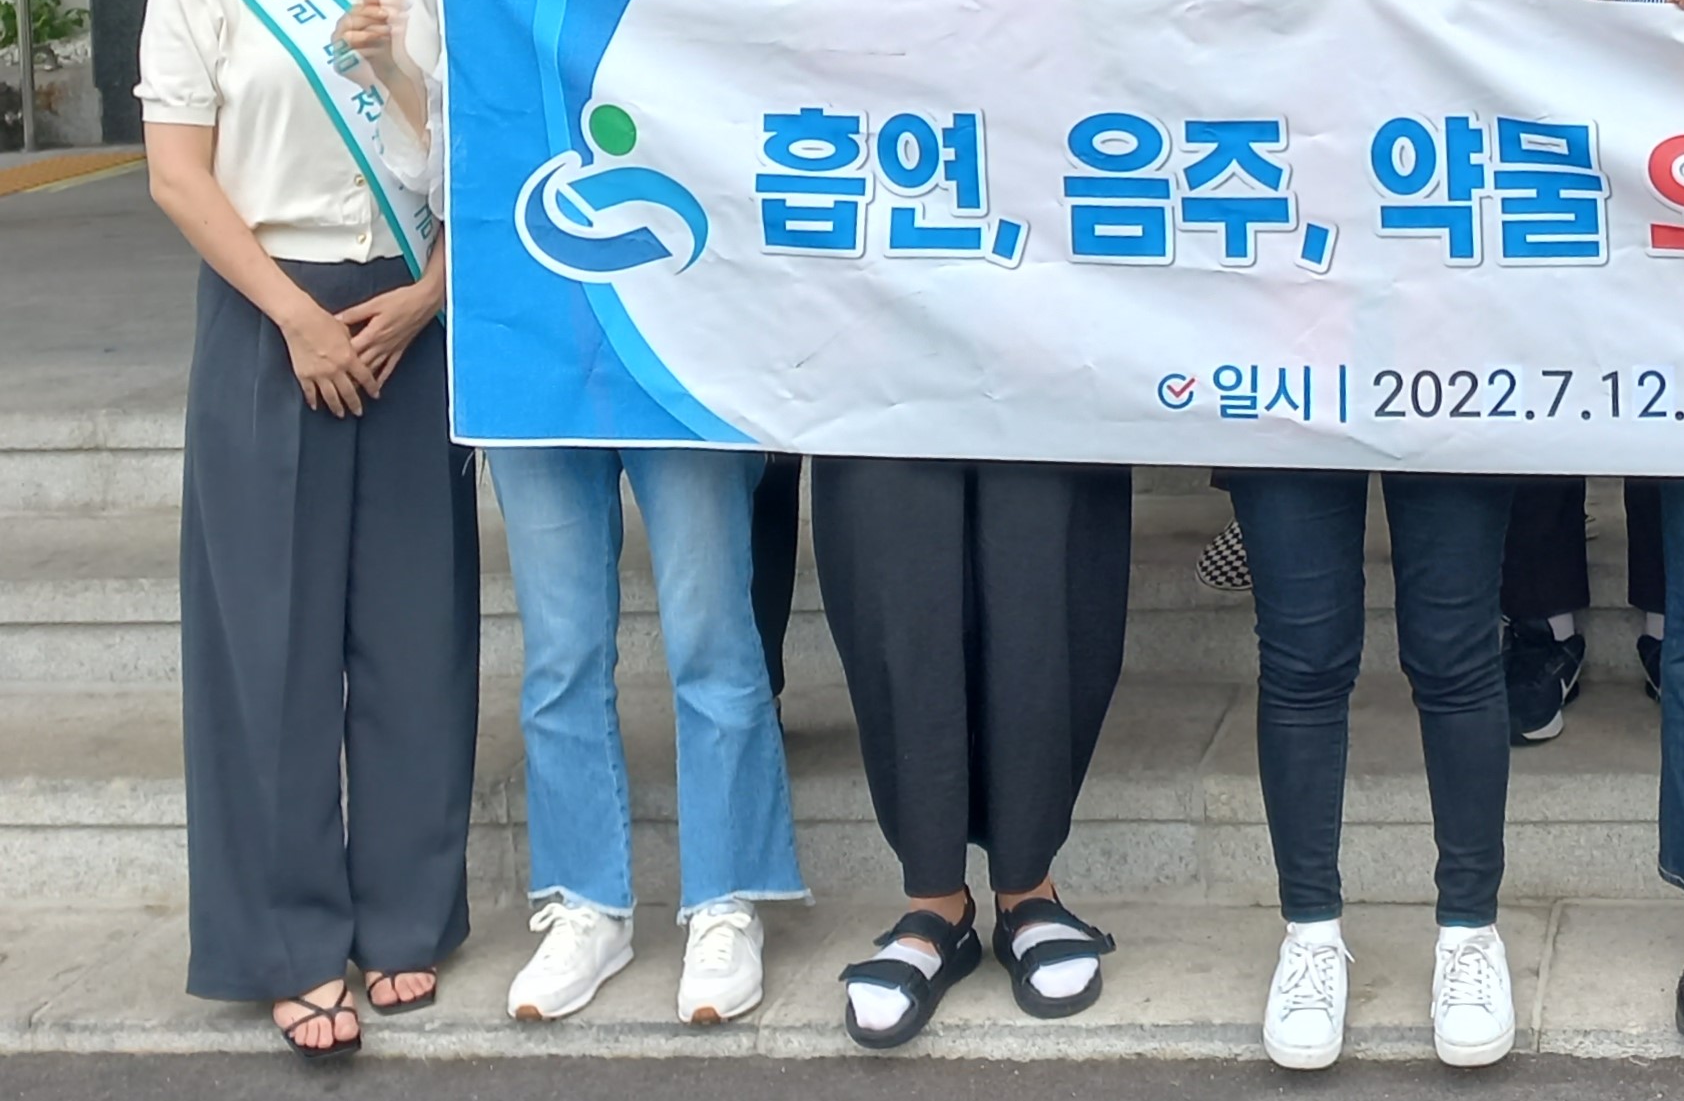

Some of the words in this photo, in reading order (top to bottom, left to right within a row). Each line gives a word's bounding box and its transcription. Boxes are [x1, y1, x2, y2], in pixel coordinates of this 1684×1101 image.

[755, 107, 1021, 261] 흡연,
[1063, 111, 1330, 264] 음주,
[1370, 111, 1603, 260] 약물
[1212, 363, 1312, 422] 일시
